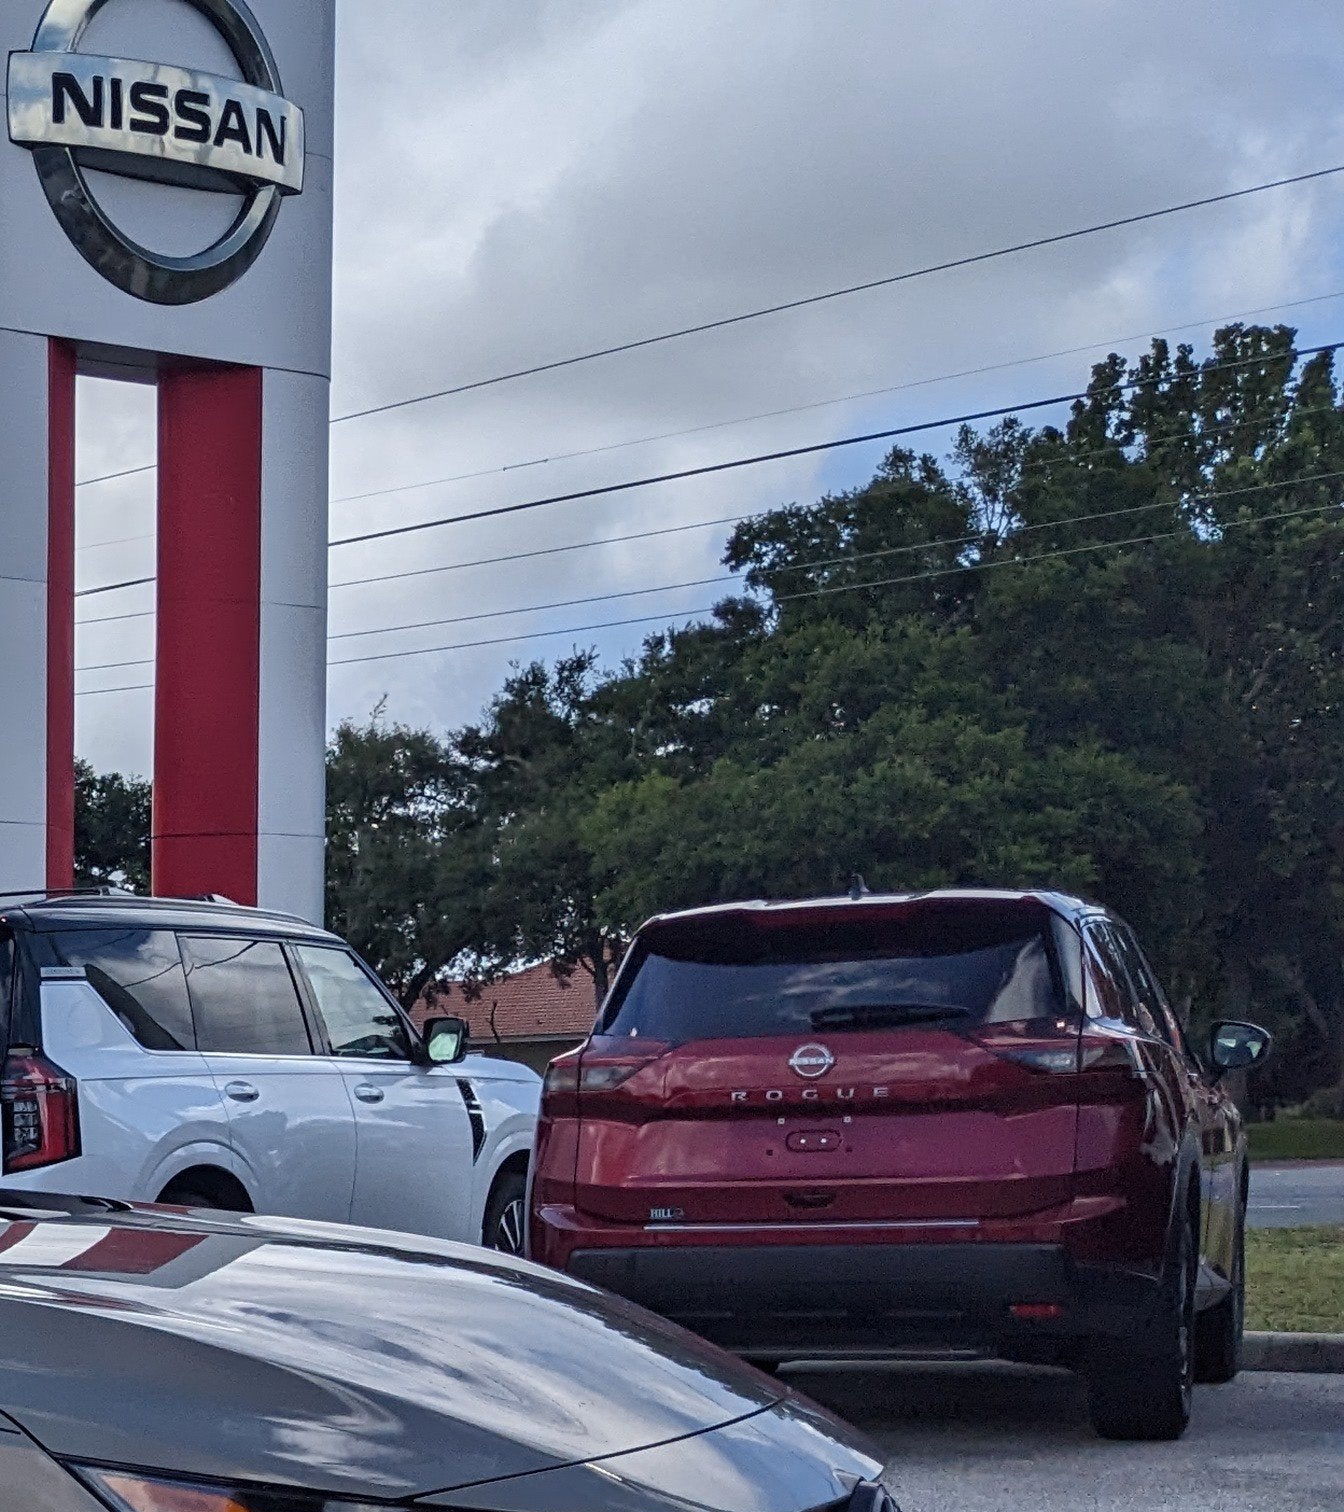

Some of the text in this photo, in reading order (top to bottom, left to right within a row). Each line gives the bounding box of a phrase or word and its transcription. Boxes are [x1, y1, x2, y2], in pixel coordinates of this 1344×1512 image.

[50, 72, 287, 166] NISSAN
[788, 1056, 835, 1067] NISSAN
[731, 1086, 889, 1102] ROGUE
[650, 1208, 672, 1218] HILL
